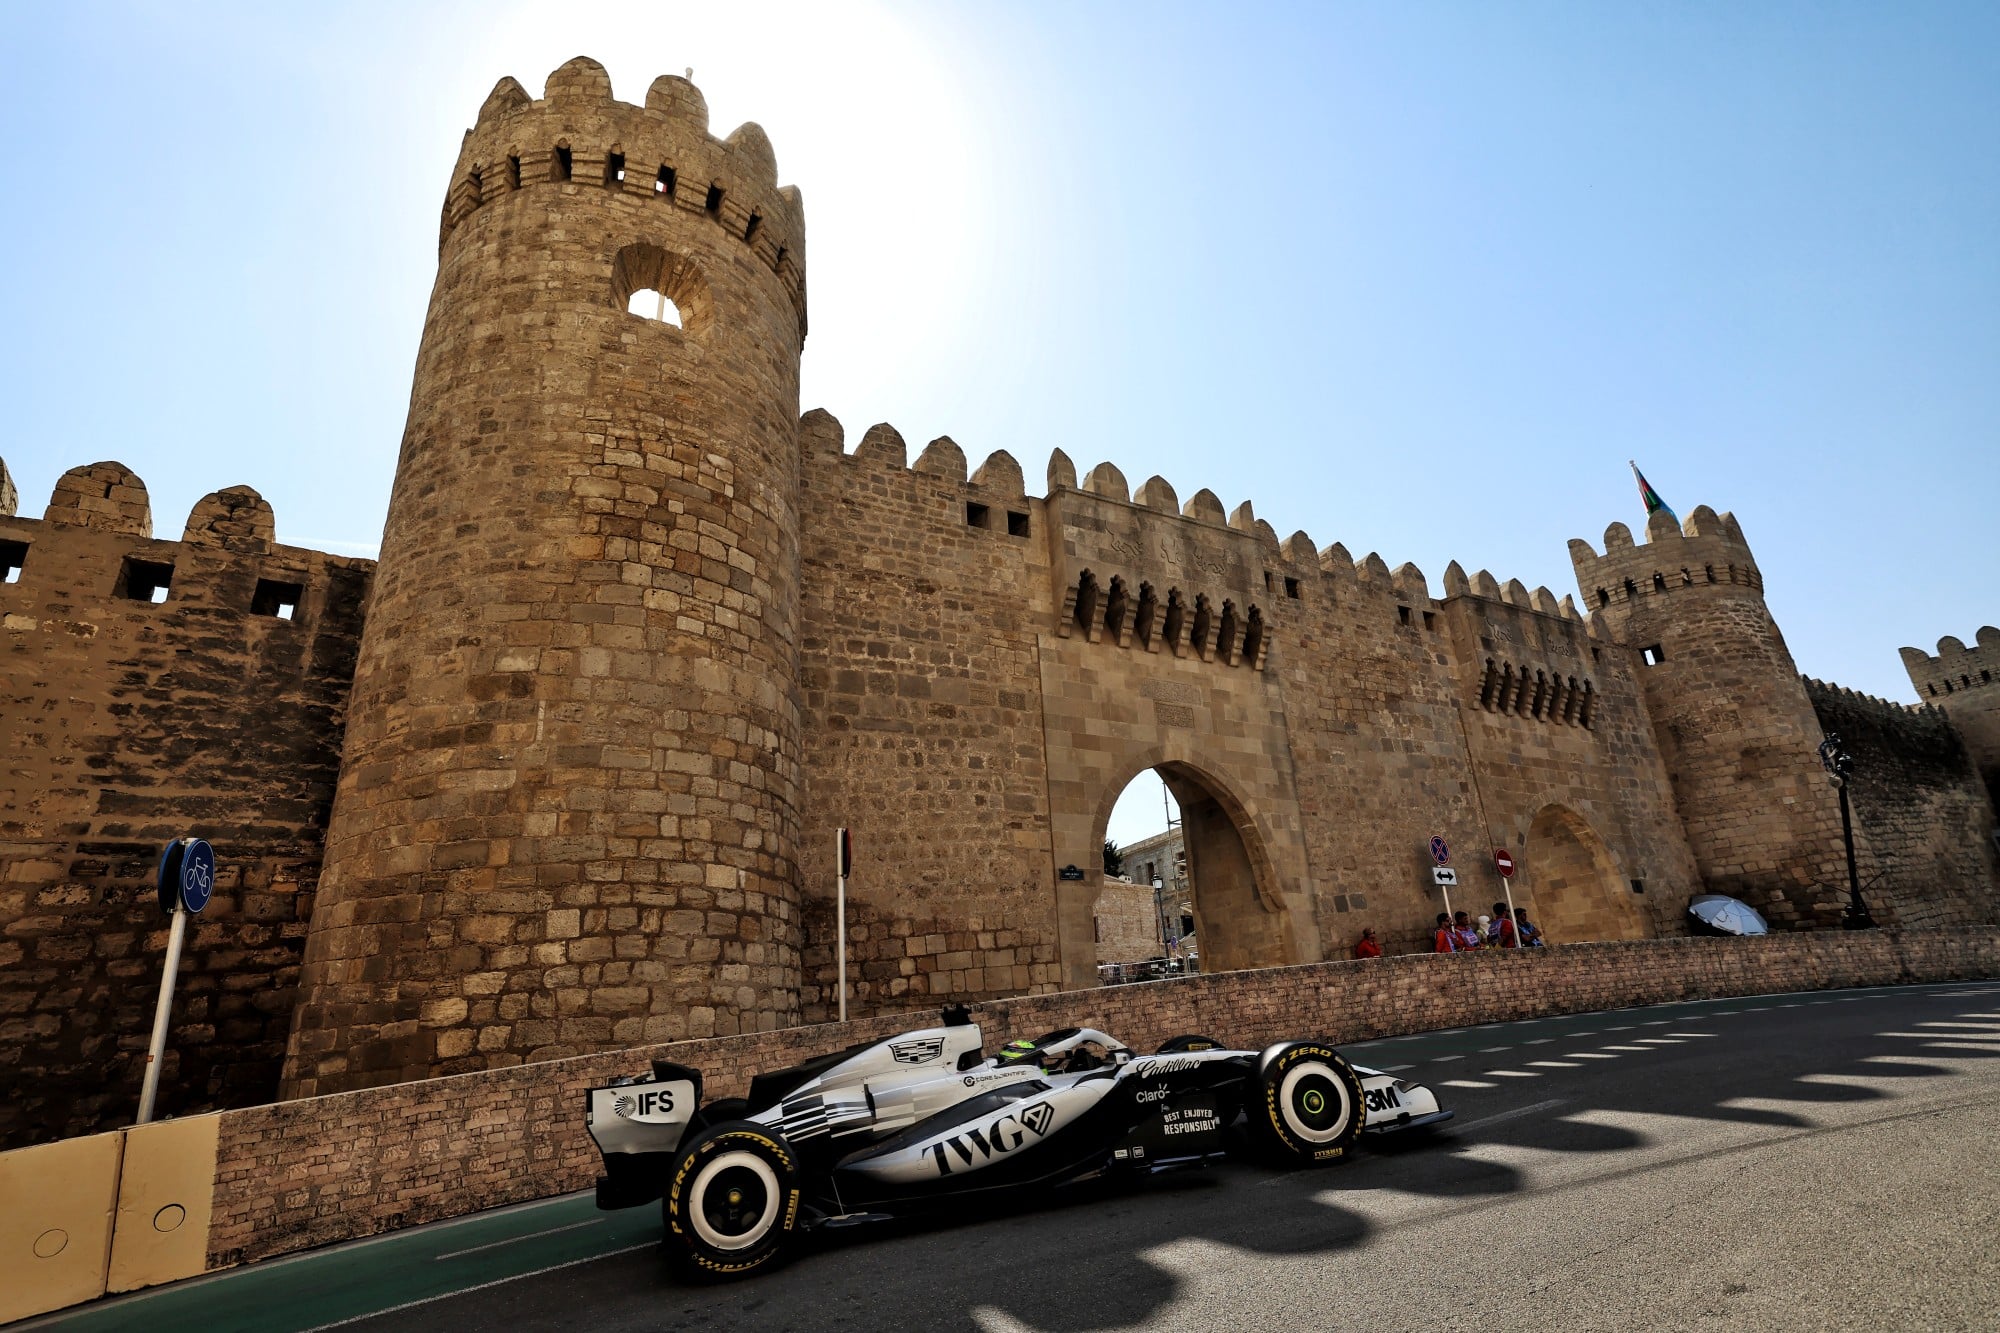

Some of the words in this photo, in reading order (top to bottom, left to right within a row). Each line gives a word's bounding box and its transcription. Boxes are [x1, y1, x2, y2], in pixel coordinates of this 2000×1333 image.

[1136, 1058, 1201, 1079] Cadillac
[1279, 1057, 1287, 1070] P
[1289, 1047, 1333, 1061] ZERO
[638, 1090, 674, 1116] IFS
[1136, 1086, 1168, 1103] Claro
[1364, 1087, 1401, 1112] 3M
[1163, 1111, 1180, 1123] BEST
[1184, 1109, 1213, 1118] ENJOYED
[1164, 1119, 1217, 1135] RESPONSIBLY
[921, 1114, 1024, 1176] TWG
[669, 1153, 696, 1216] ZERO
[783, 1189, 800, 1230] PIRELLI
[671, 1220, 683, 1234] P
